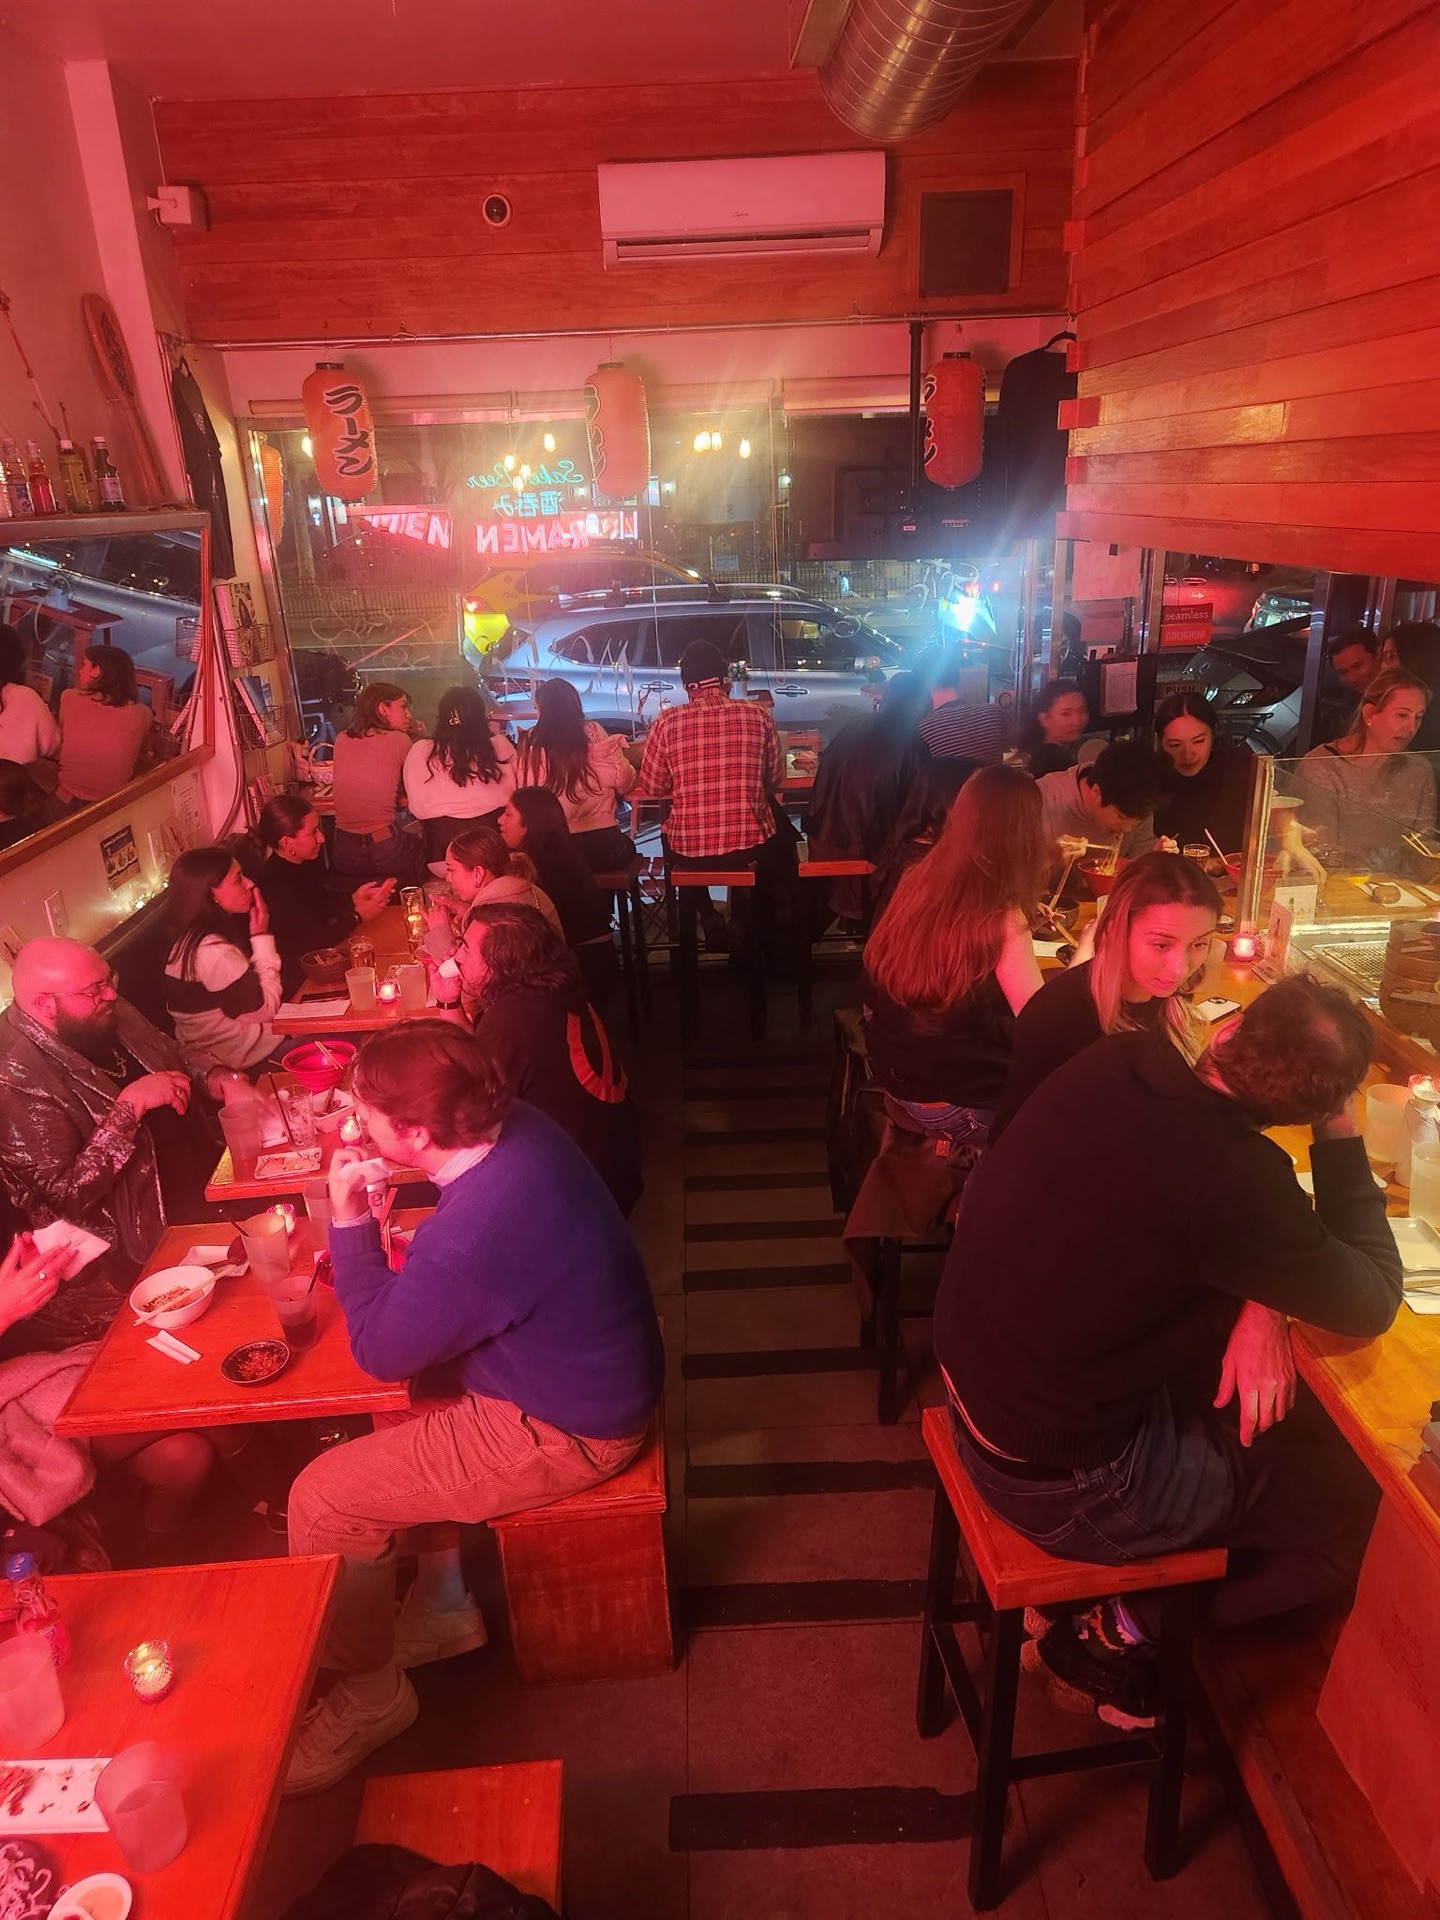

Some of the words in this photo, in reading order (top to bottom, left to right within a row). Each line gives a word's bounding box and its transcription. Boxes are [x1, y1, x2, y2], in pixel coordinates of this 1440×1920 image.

[324, 385, 373, 476] ラーメン
[1165, 610, 1209, 621] seamless
[1165, 630, 1206, 641] GRUBHUB
[1165, 685, 1195, 695] PUSH
